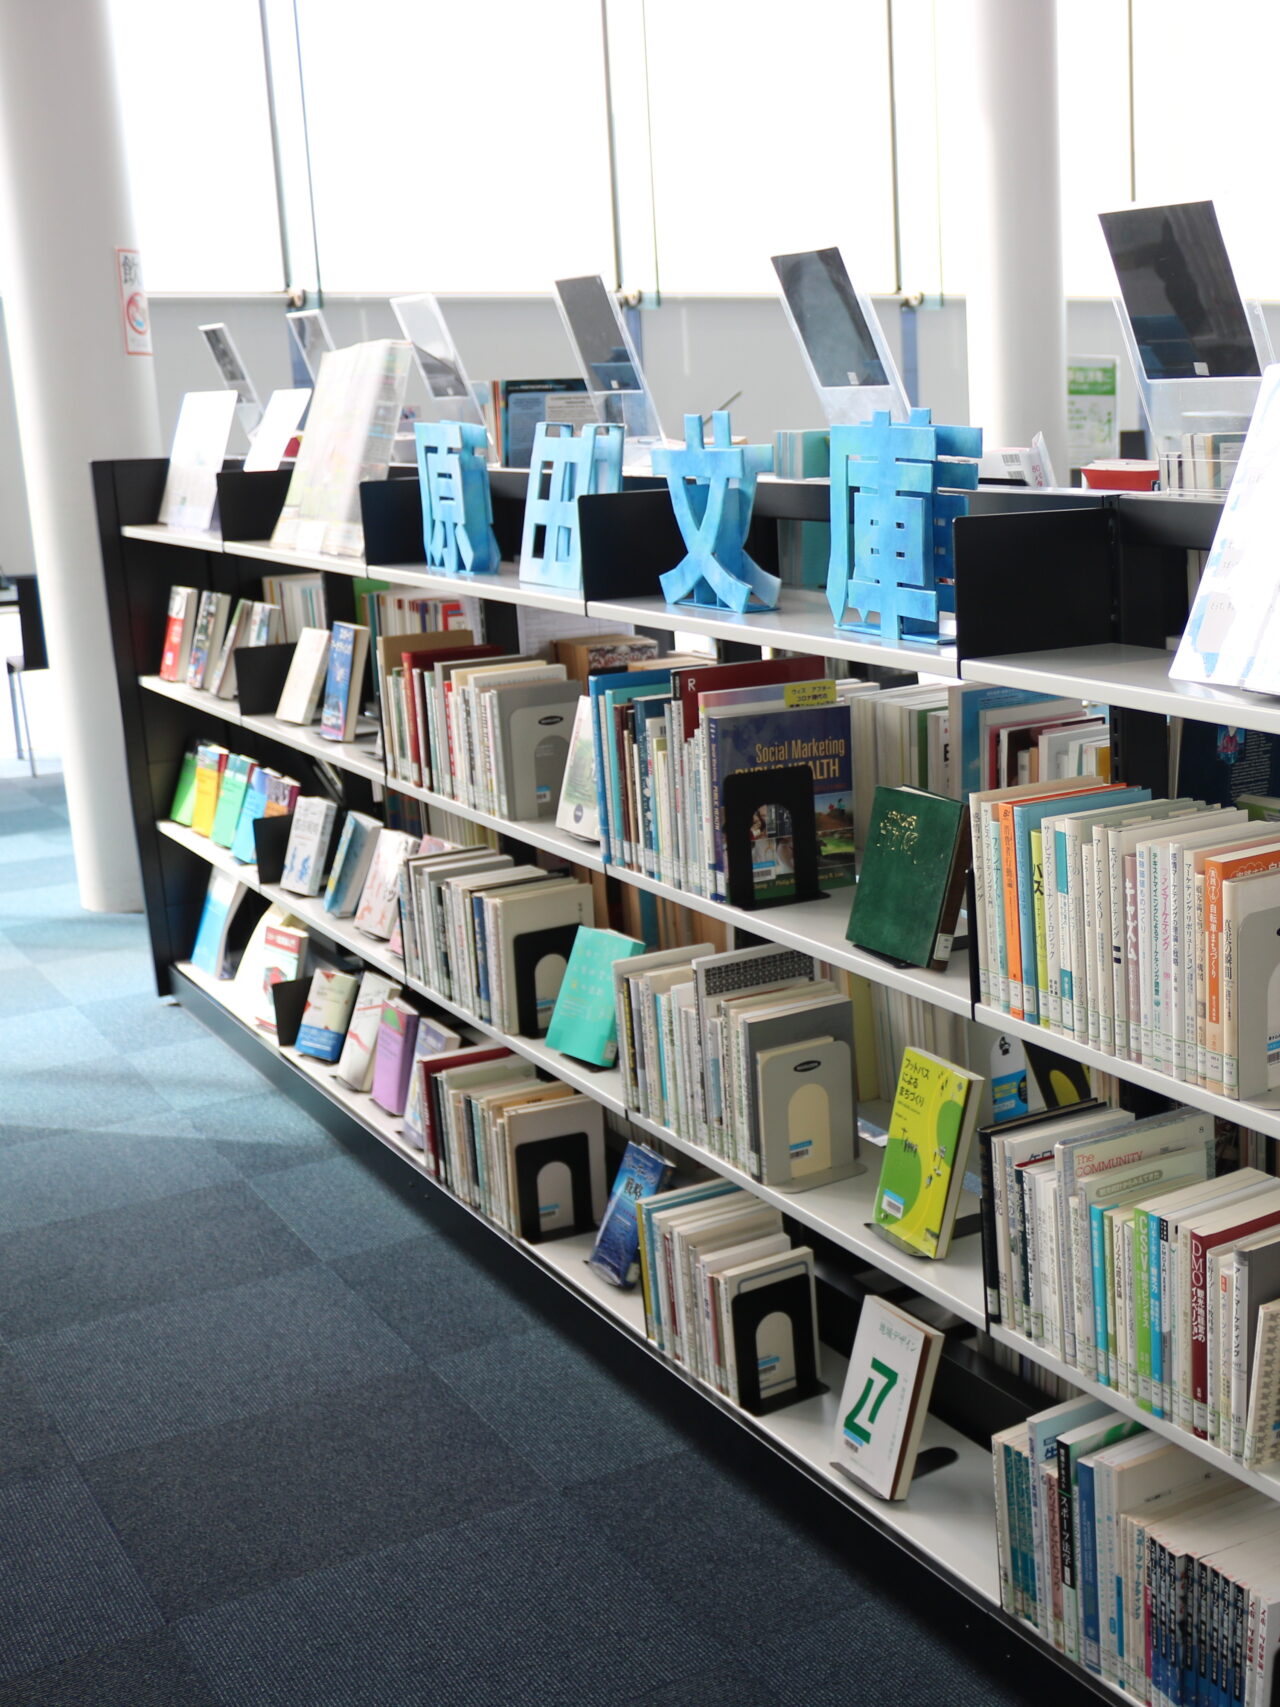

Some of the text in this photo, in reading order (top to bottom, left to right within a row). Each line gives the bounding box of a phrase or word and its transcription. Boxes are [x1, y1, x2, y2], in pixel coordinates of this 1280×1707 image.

[755, 736, 846, 764] Social Marketing
[789, 758, 840, 780] ALTH
[902, 1073, 919, 1089] による
[899, 1087, 925, 1107] まちづくり
[1075, 1150, 1143, 1178] COMMUNITY
[1076, 1153, 1096, 1165] The
